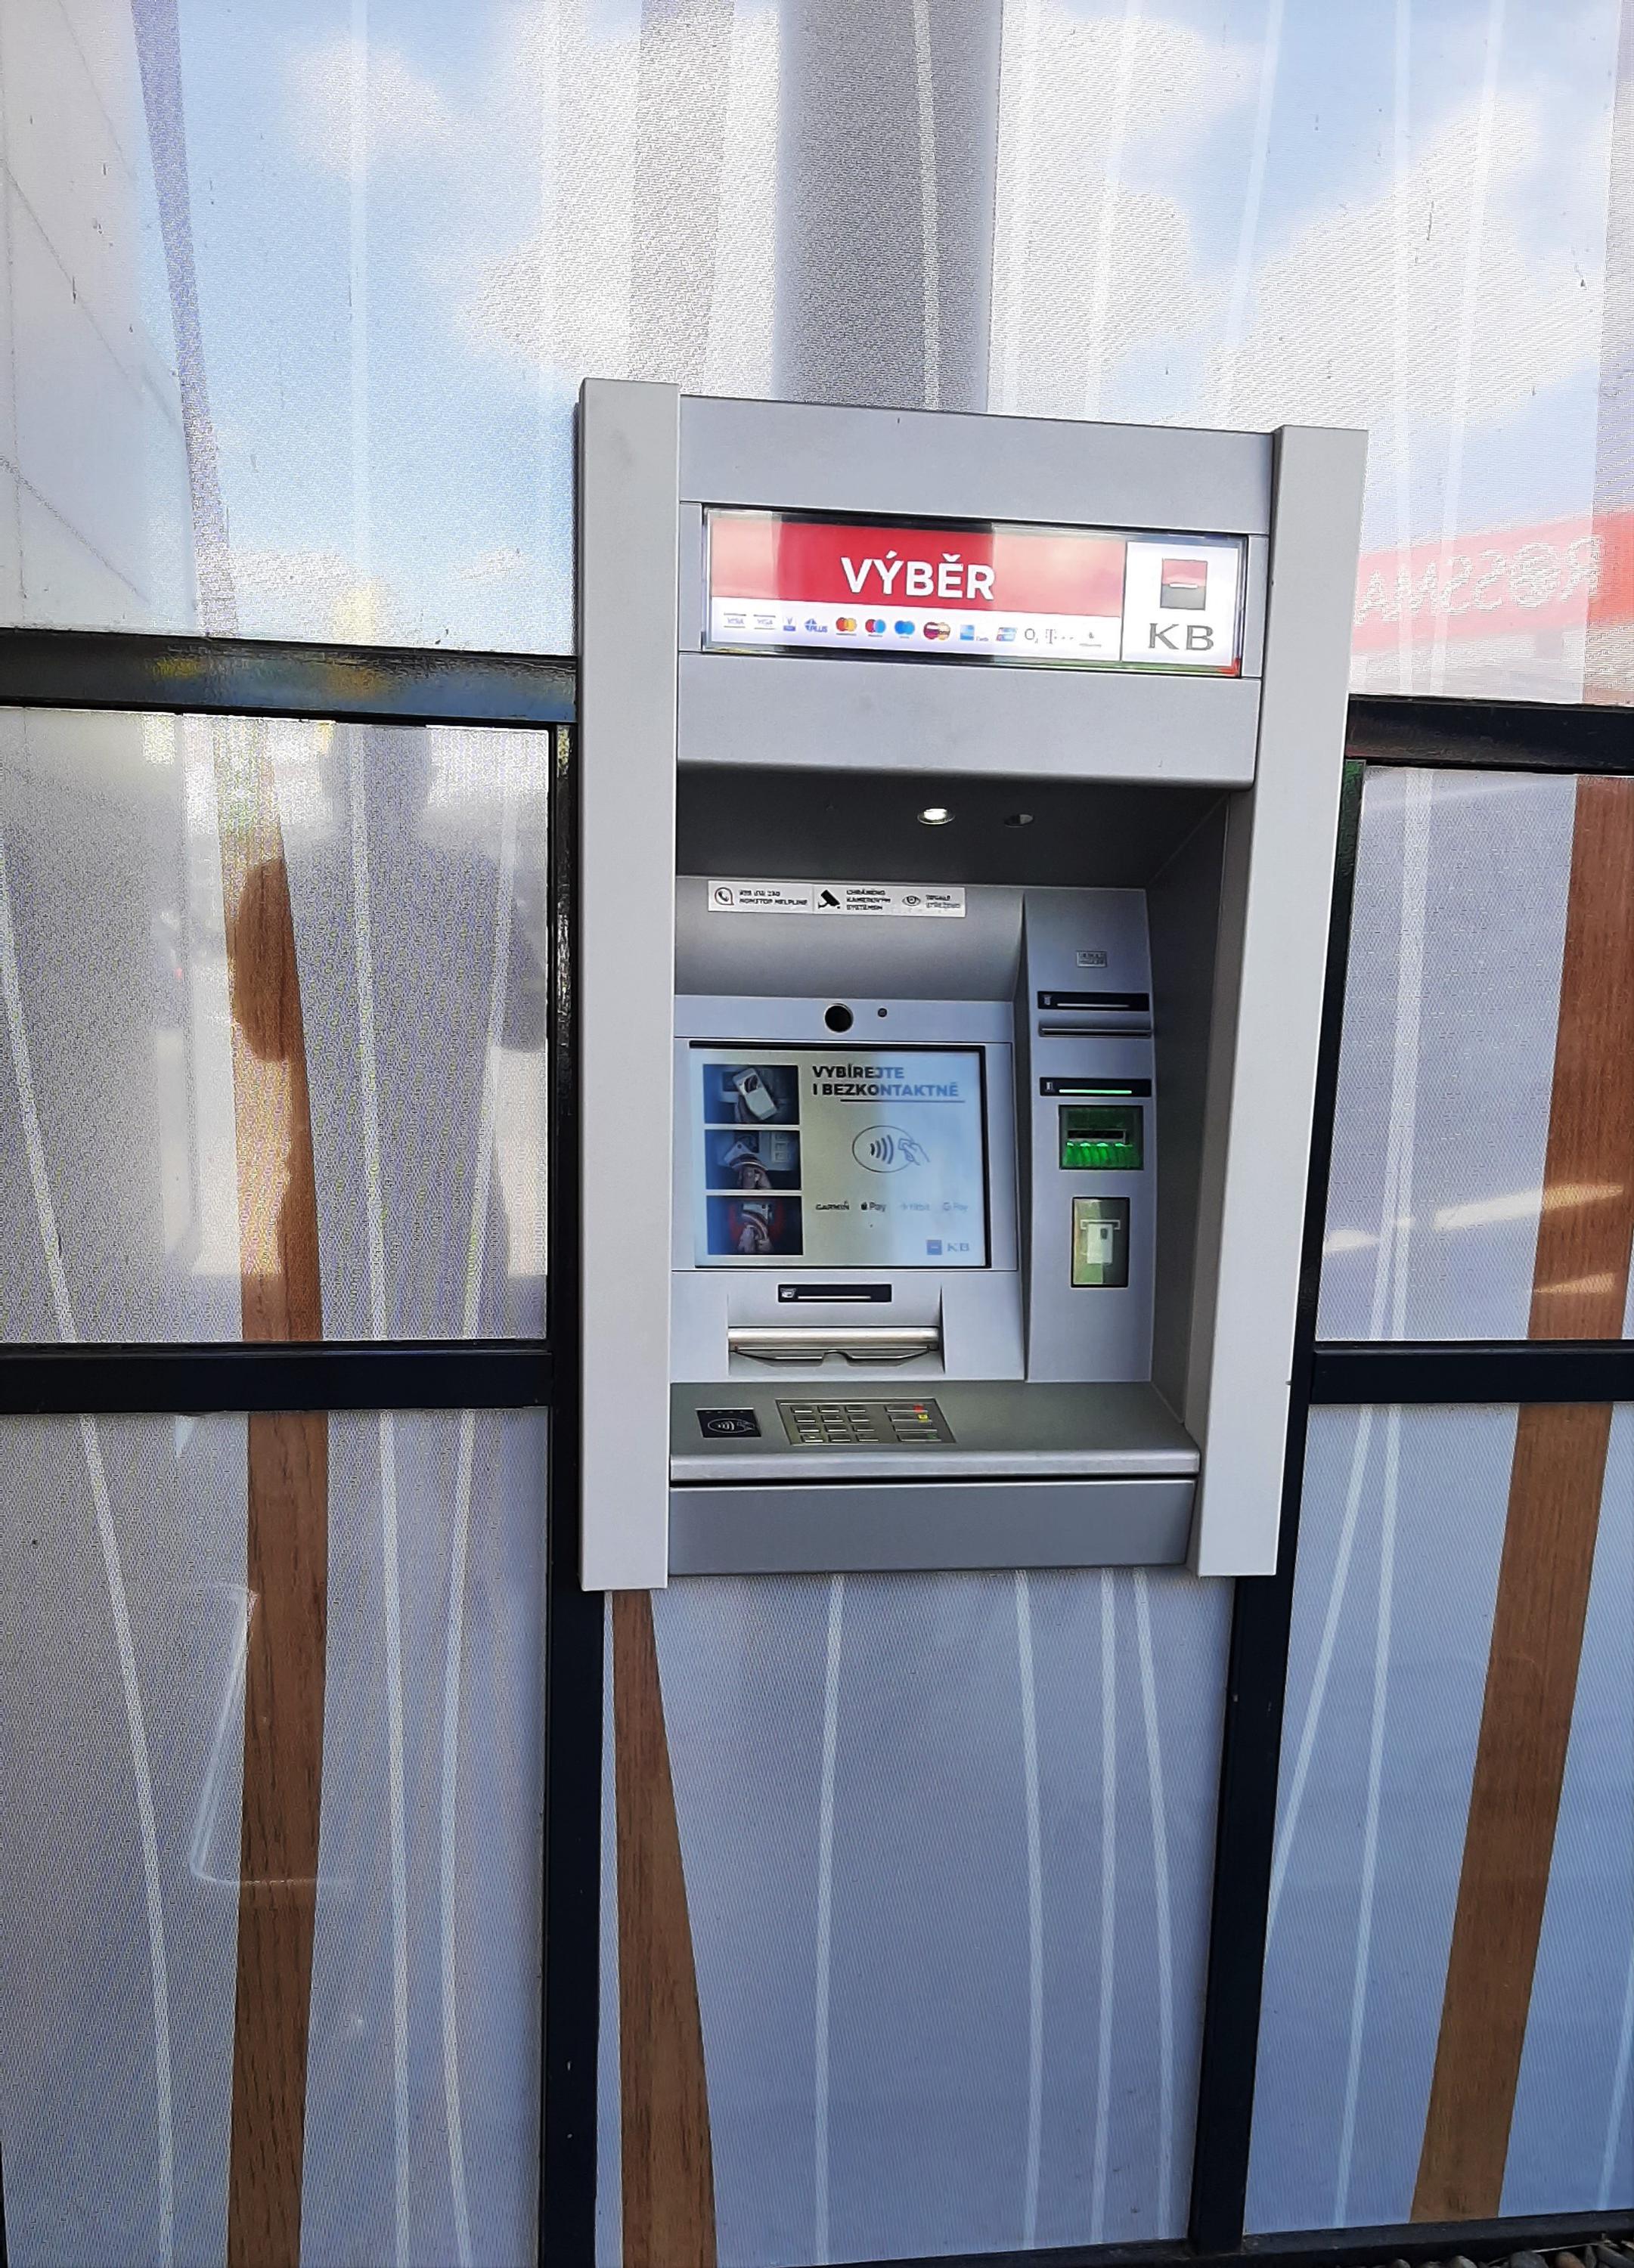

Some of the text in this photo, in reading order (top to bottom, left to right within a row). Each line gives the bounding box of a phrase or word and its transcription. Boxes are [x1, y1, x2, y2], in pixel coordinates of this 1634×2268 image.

[840, 550, 995, 600] VÝBĚR
[1148, 623, 1214, 651] KB
[812, 1063, 904, 1079] VYBÍREJTE
[813, 1083, 818, 1095] I
[870, 1202, 887, 1212] Pay
[947, 1243, 969, 1251] KB
